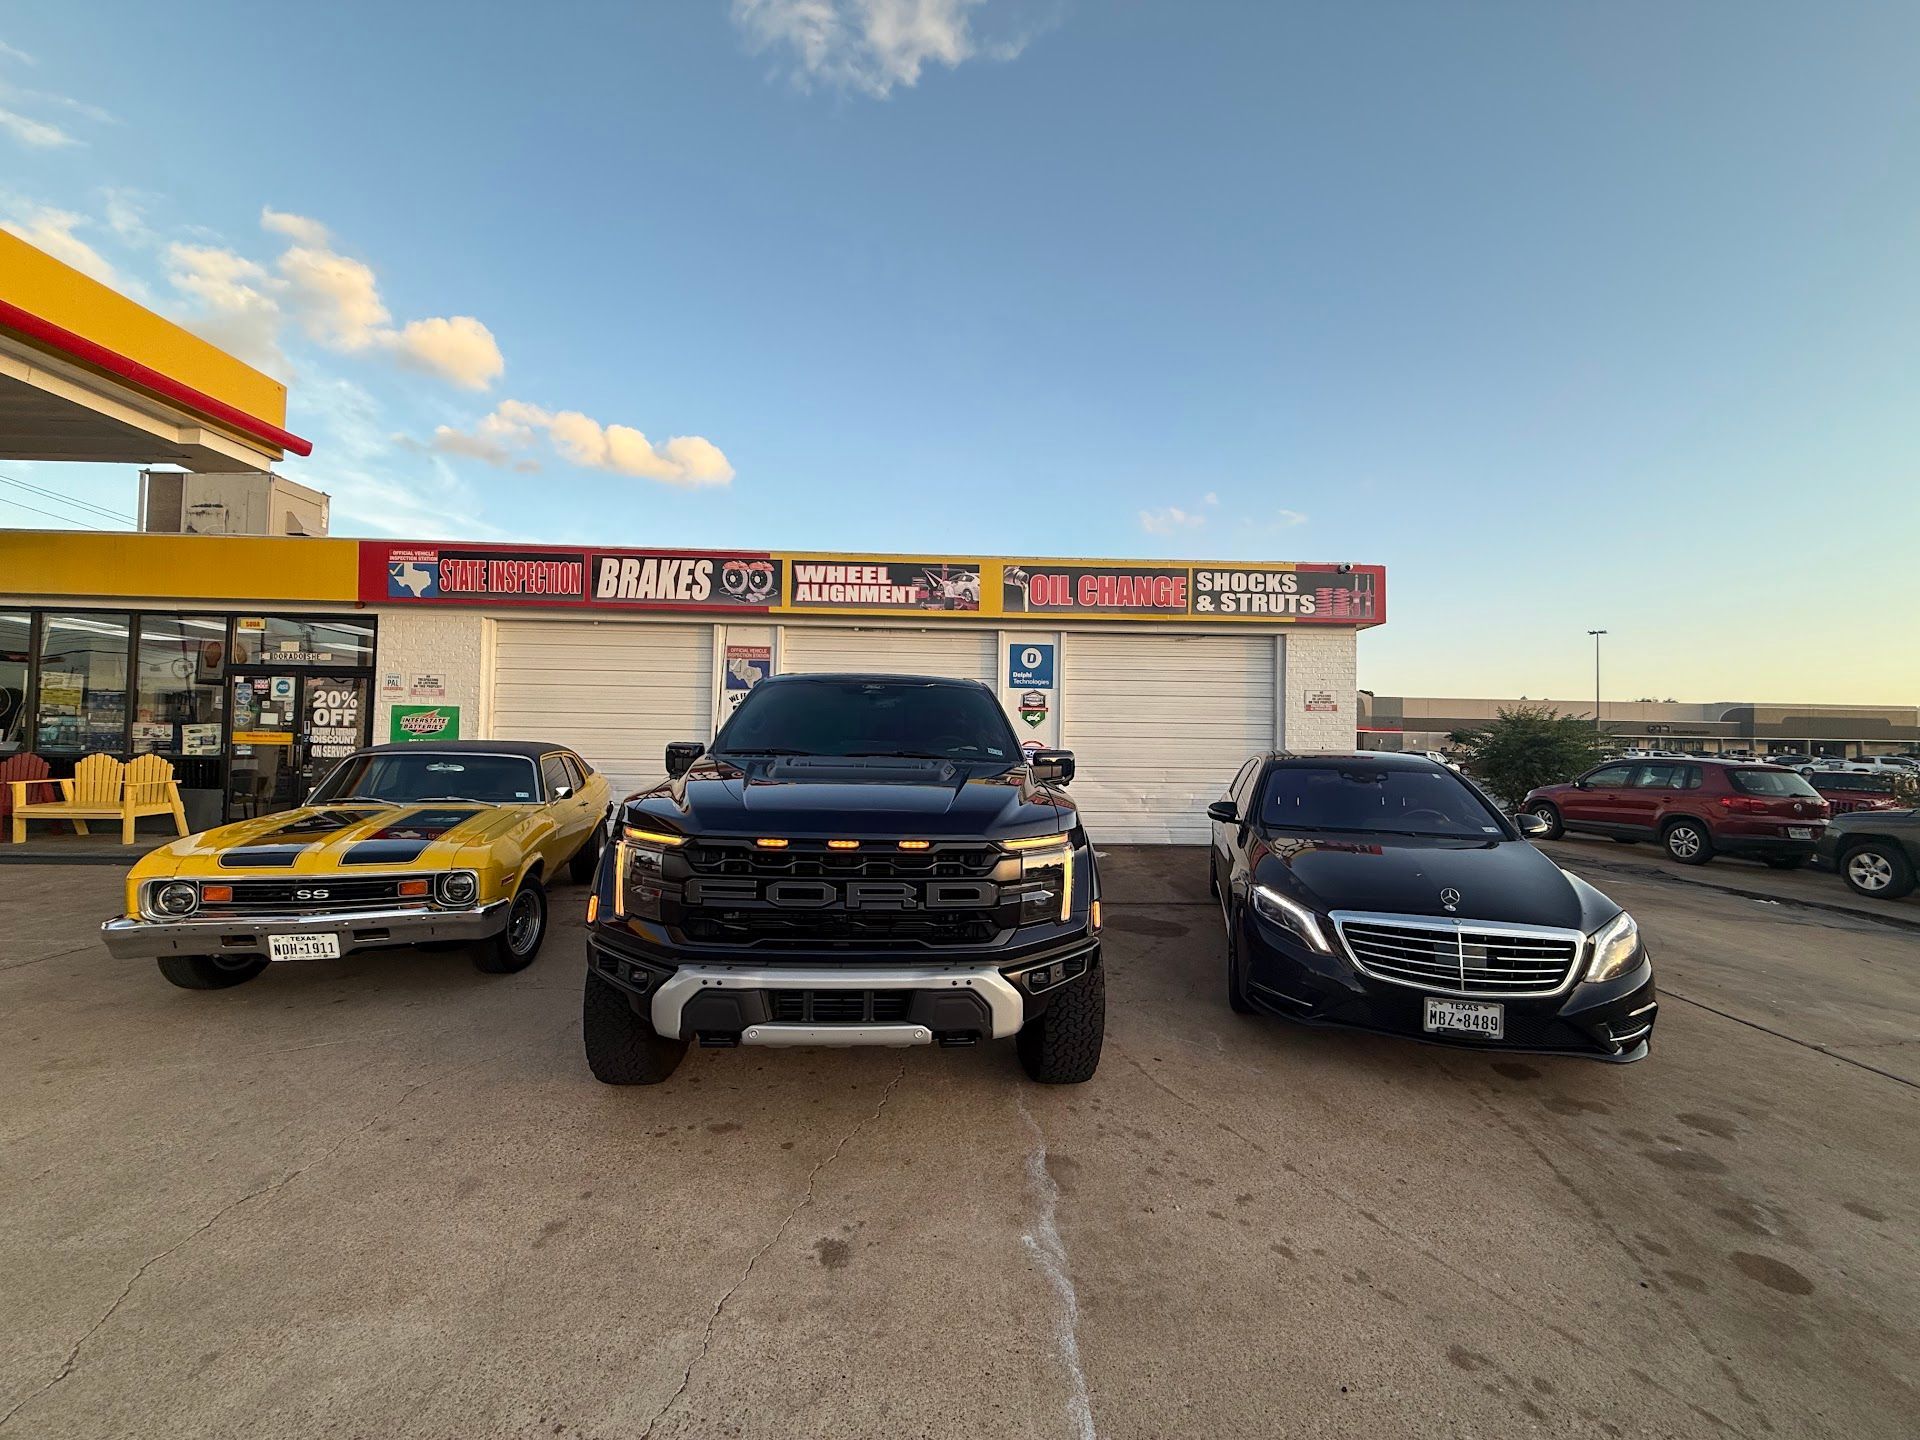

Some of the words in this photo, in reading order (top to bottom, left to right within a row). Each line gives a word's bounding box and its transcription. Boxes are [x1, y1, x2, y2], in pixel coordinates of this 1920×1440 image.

[440, 559, 487, 592] STATE
[488, 560, 582, 594] INSPECTION
[597, 558, 714, 601] BRAKES
[794, 564, 892, 584] WHEEL
[1196, 572, 1298, 593] SHOCKS
[795, 584, 920, 604] ALIGNMENT
[1029, 574, 1074, 606] OIL
[1077, 574, 1187, 608] CHANGE
[1196, 595, 1215, 612] &
[1220, 593, 1316, 614] STRUTS
[1027, 653, 1037, 664] D
[387, 679, 399, 687] PAL
[1013, 671, 1032, 679] Delphi
[1013, 678, 1050, 686] Technologies
[312, 690, 358, 709] 20%
[313, 708, 357, 727] OFF
[312, 735, 356, 745] DISCOUNT
[311, 745, 322, 758] ON
[322, 745, 356, 758] SERVICES
[296, 889, 330, 900] SS
[685, 878, 1001, 910] FORD
[1450, 1002, 1479, 1012] TEXAS
